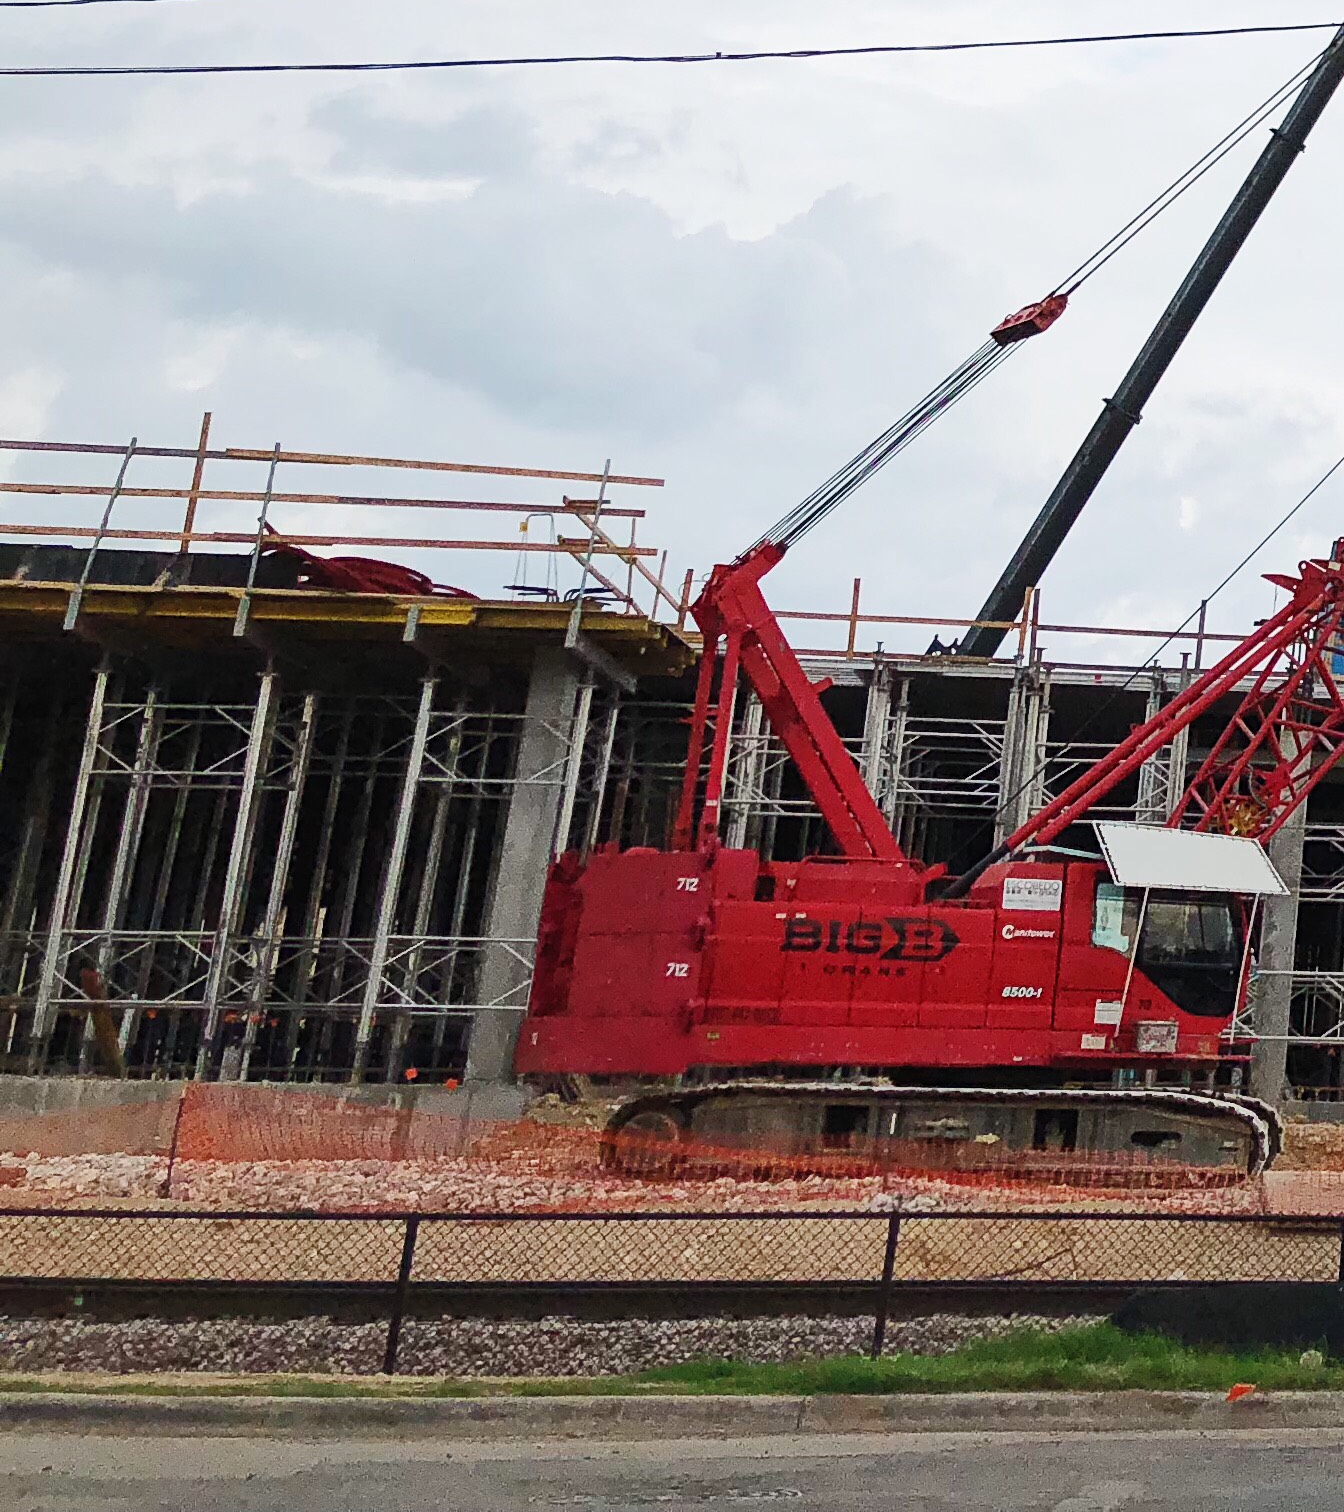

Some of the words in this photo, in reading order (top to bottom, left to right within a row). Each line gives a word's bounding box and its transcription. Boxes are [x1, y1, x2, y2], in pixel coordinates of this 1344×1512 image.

[676, 877, 699, 892] 712
[780, 918, 883, 955] BIG
[665, 962, 690, 977] 712
